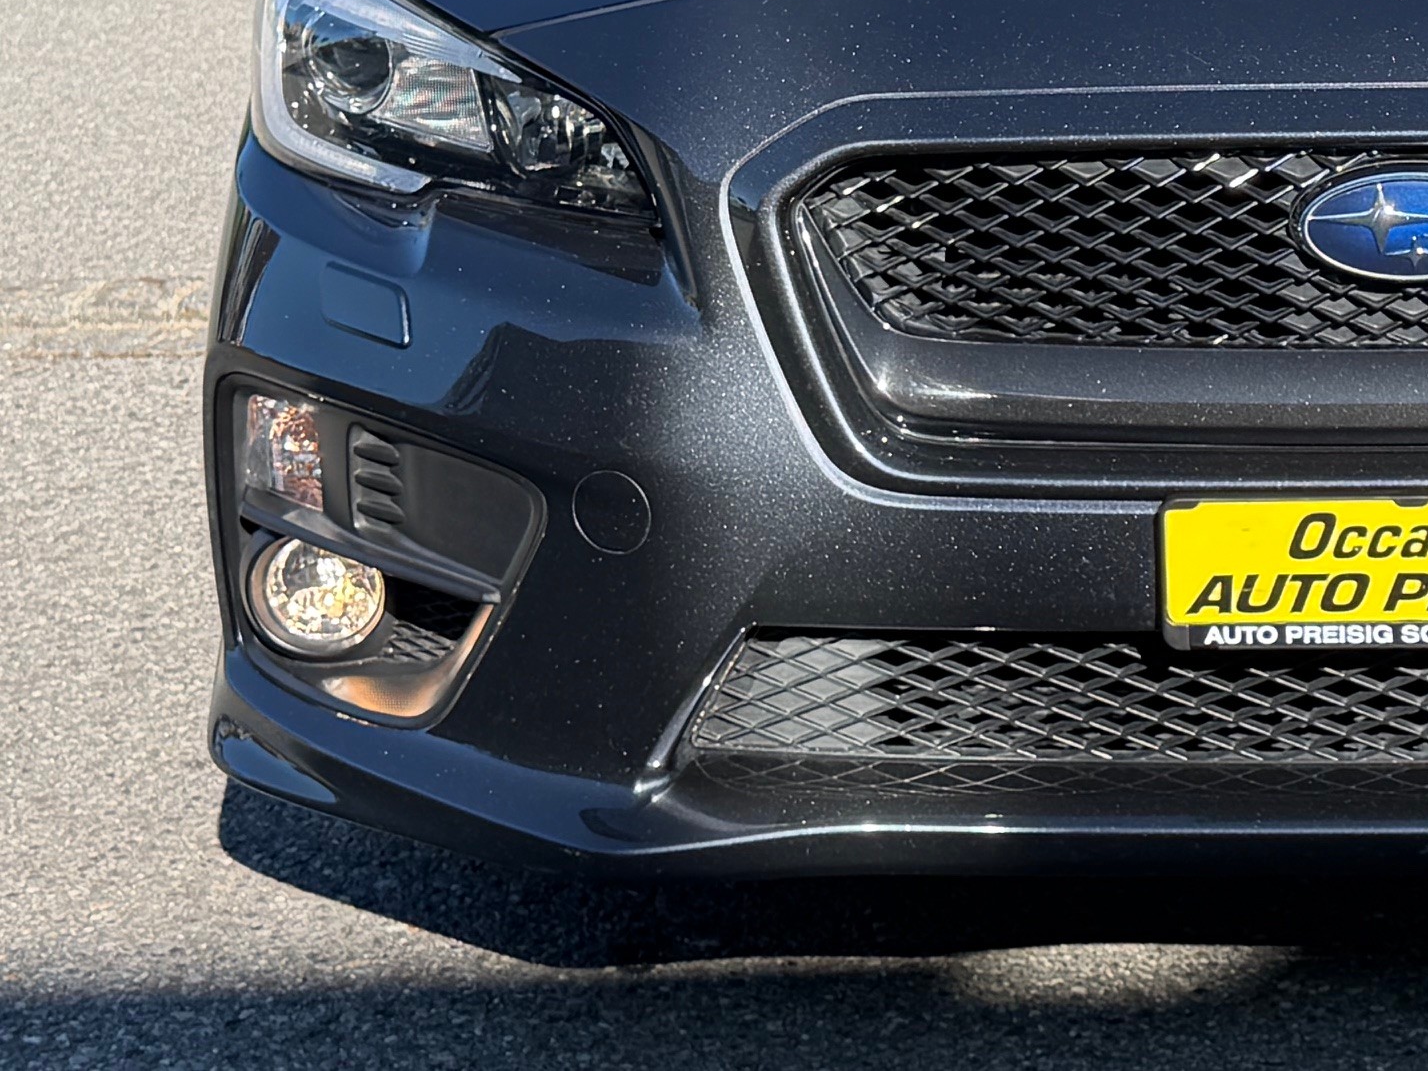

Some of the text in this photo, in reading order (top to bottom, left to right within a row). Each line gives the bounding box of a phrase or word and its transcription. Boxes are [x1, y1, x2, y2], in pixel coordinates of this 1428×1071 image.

[1185, 572, 1373, 615] AUTO
[1204, 625, 1278, 646] AUTO
[1285, 624, 1394, 645] PREISIG
